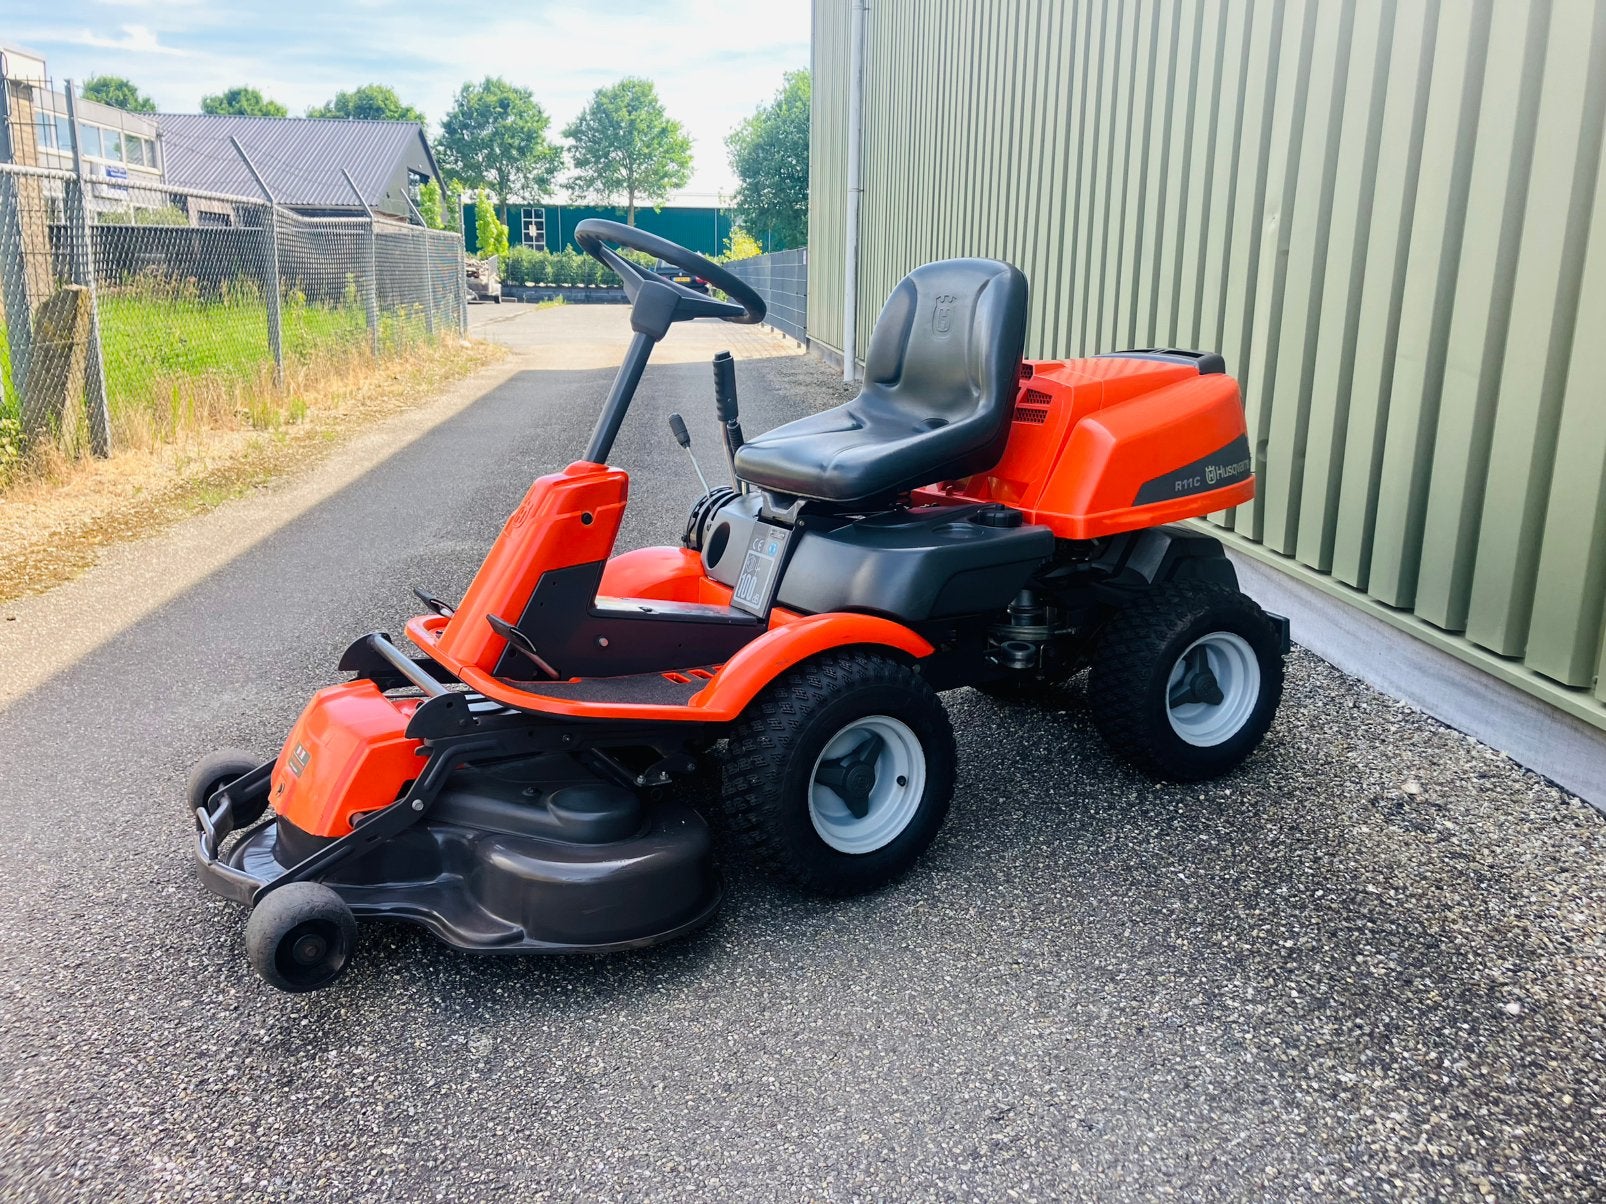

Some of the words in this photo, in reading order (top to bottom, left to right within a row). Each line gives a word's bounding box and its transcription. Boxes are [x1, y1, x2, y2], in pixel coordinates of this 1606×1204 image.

[1175, 477, 1201, 492] R11C
[1215, 459, 1250, 480] Husqvarn
[737, 573, 758, 601] 100
